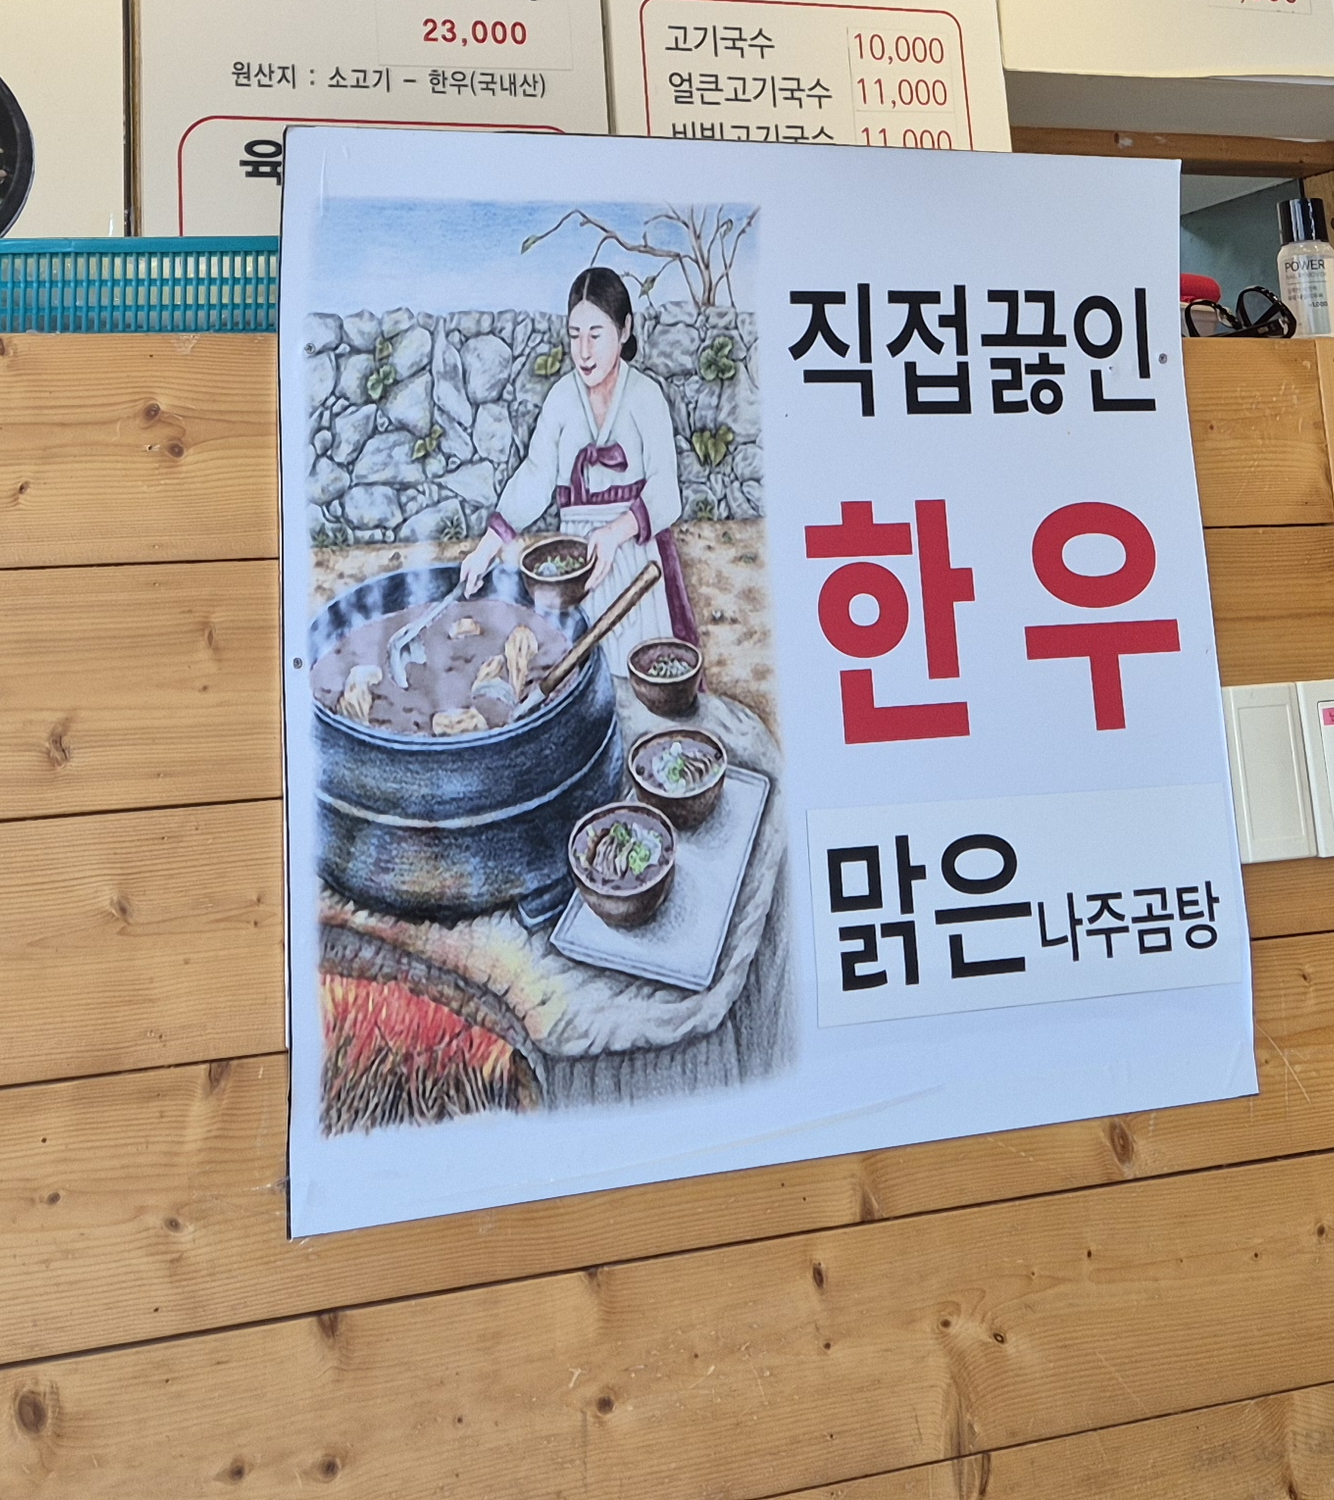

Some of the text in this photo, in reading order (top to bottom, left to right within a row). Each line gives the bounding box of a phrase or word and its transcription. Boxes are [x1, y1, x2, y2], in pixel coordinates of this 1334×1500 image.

[421, 17, 527, 46] 23,000
[665, 25, 945, 65] 고기국수 10,000
[231, 61, 297, 91] 원산지
[328, 67, 392, 94] 소고기
[428, 68, 546, 98] 한우(국내산)
[668, 72, 947, 109] 얼큰고기국수 11,000
[1285, 260, 1325, 272] POWER
[787, 283, 1157, 418] 직접끓인
[804, 497, 1181, 745] 한우
